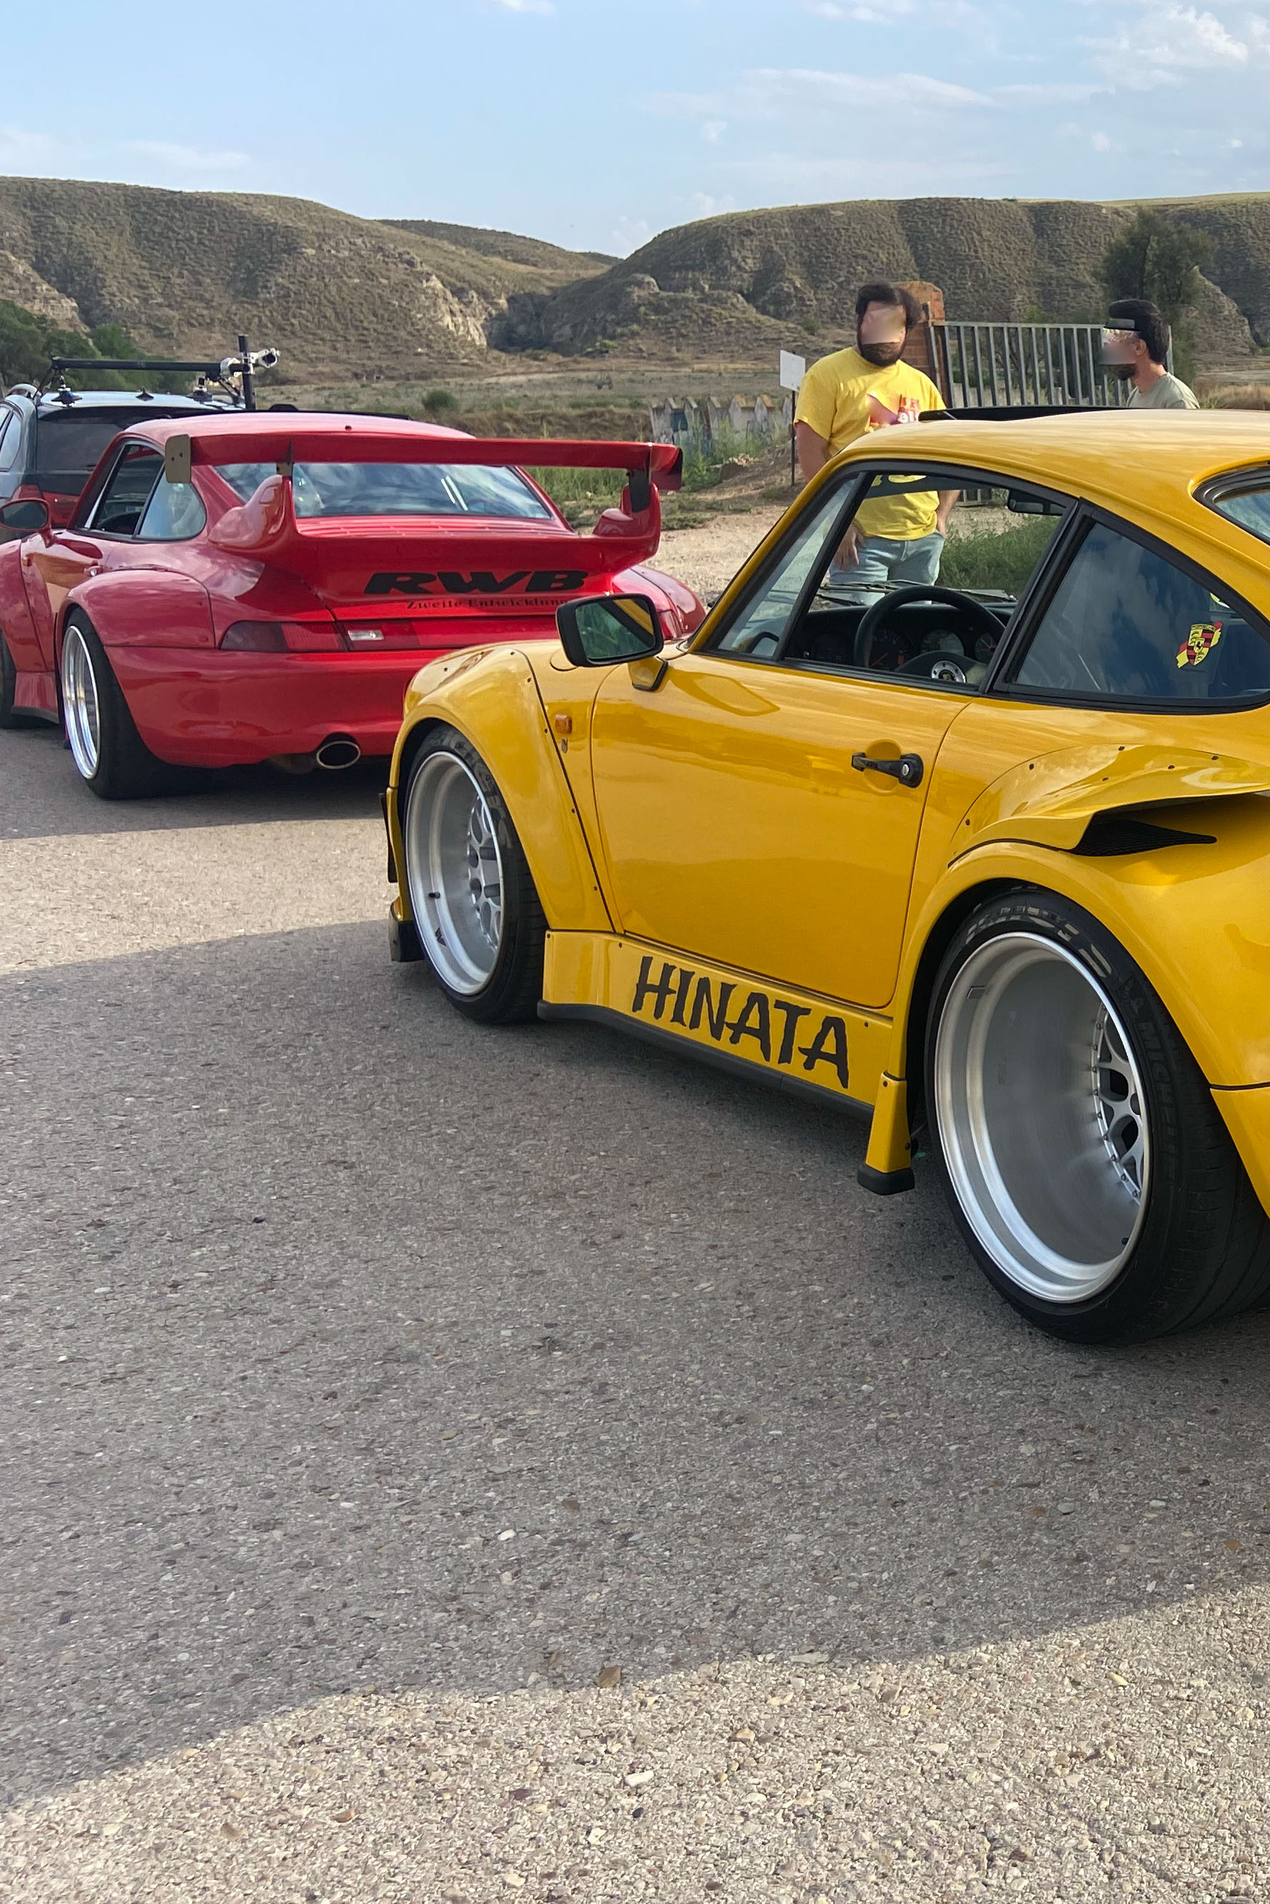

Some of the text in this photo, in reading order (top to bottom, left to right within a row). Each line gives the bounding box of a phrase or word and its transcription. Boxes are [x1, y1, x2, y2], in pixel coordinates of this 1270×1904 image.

[364, 570, 588, 594] RWB
[468, 598, 567, 608] Entwicklun
[632, 956, 849, 1089] HINATA
